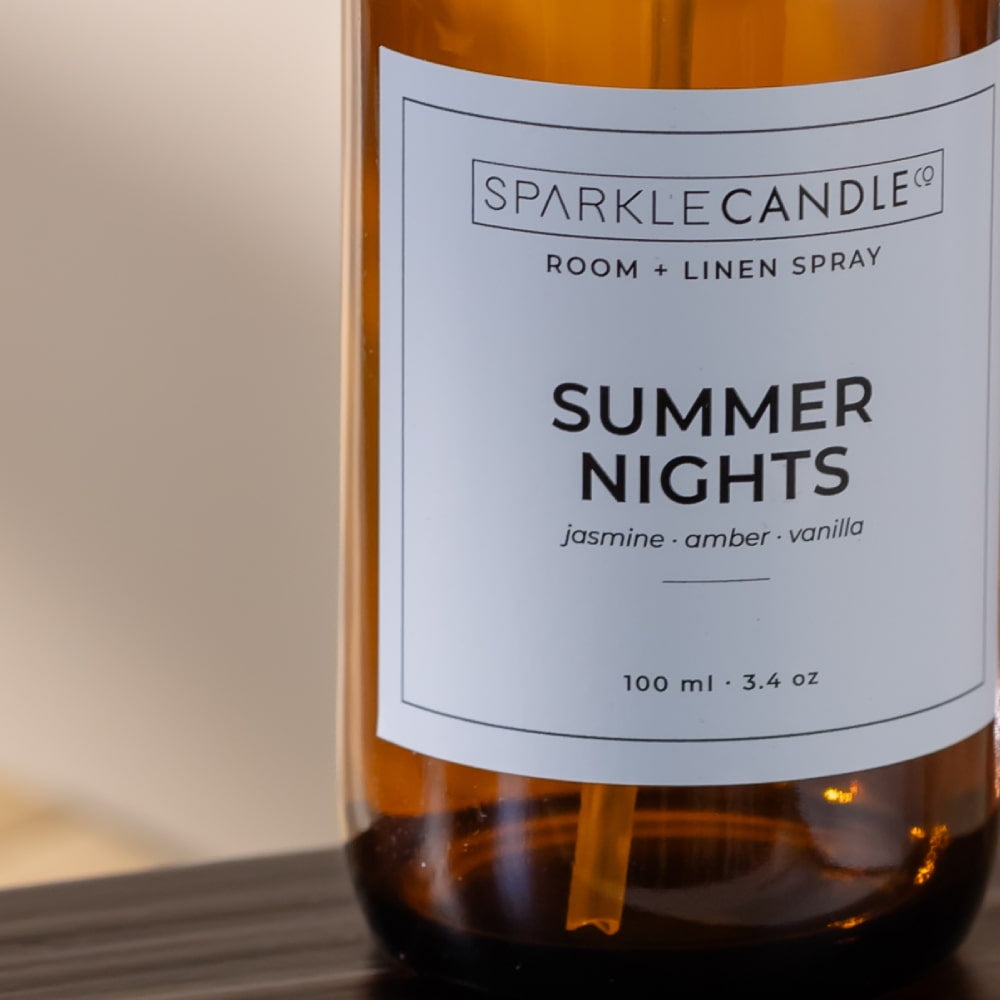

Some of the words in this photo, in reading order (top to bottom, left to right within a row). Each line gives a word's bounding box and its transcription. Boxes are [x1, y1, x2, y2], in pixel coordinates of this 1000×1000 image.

[546, 253, 638, 280] ROOM
[683, 257, 777, 281] LINEN
[791, 245, 882, 276] SPRAY
[551, 375, 873, 438] SUMMER
[581, 445, 850, 506] NIGHTS
[559, 523, 665, 549] jasmine
[684, 527, 771, 549] amber
[788, 516, 865, 544] vanilla
[623, 674, 669, 693] 100
[680, 674, 713, 693] ml
[742, 671, 782, 692] 3.4
[791, 671, 819, 687] oz
